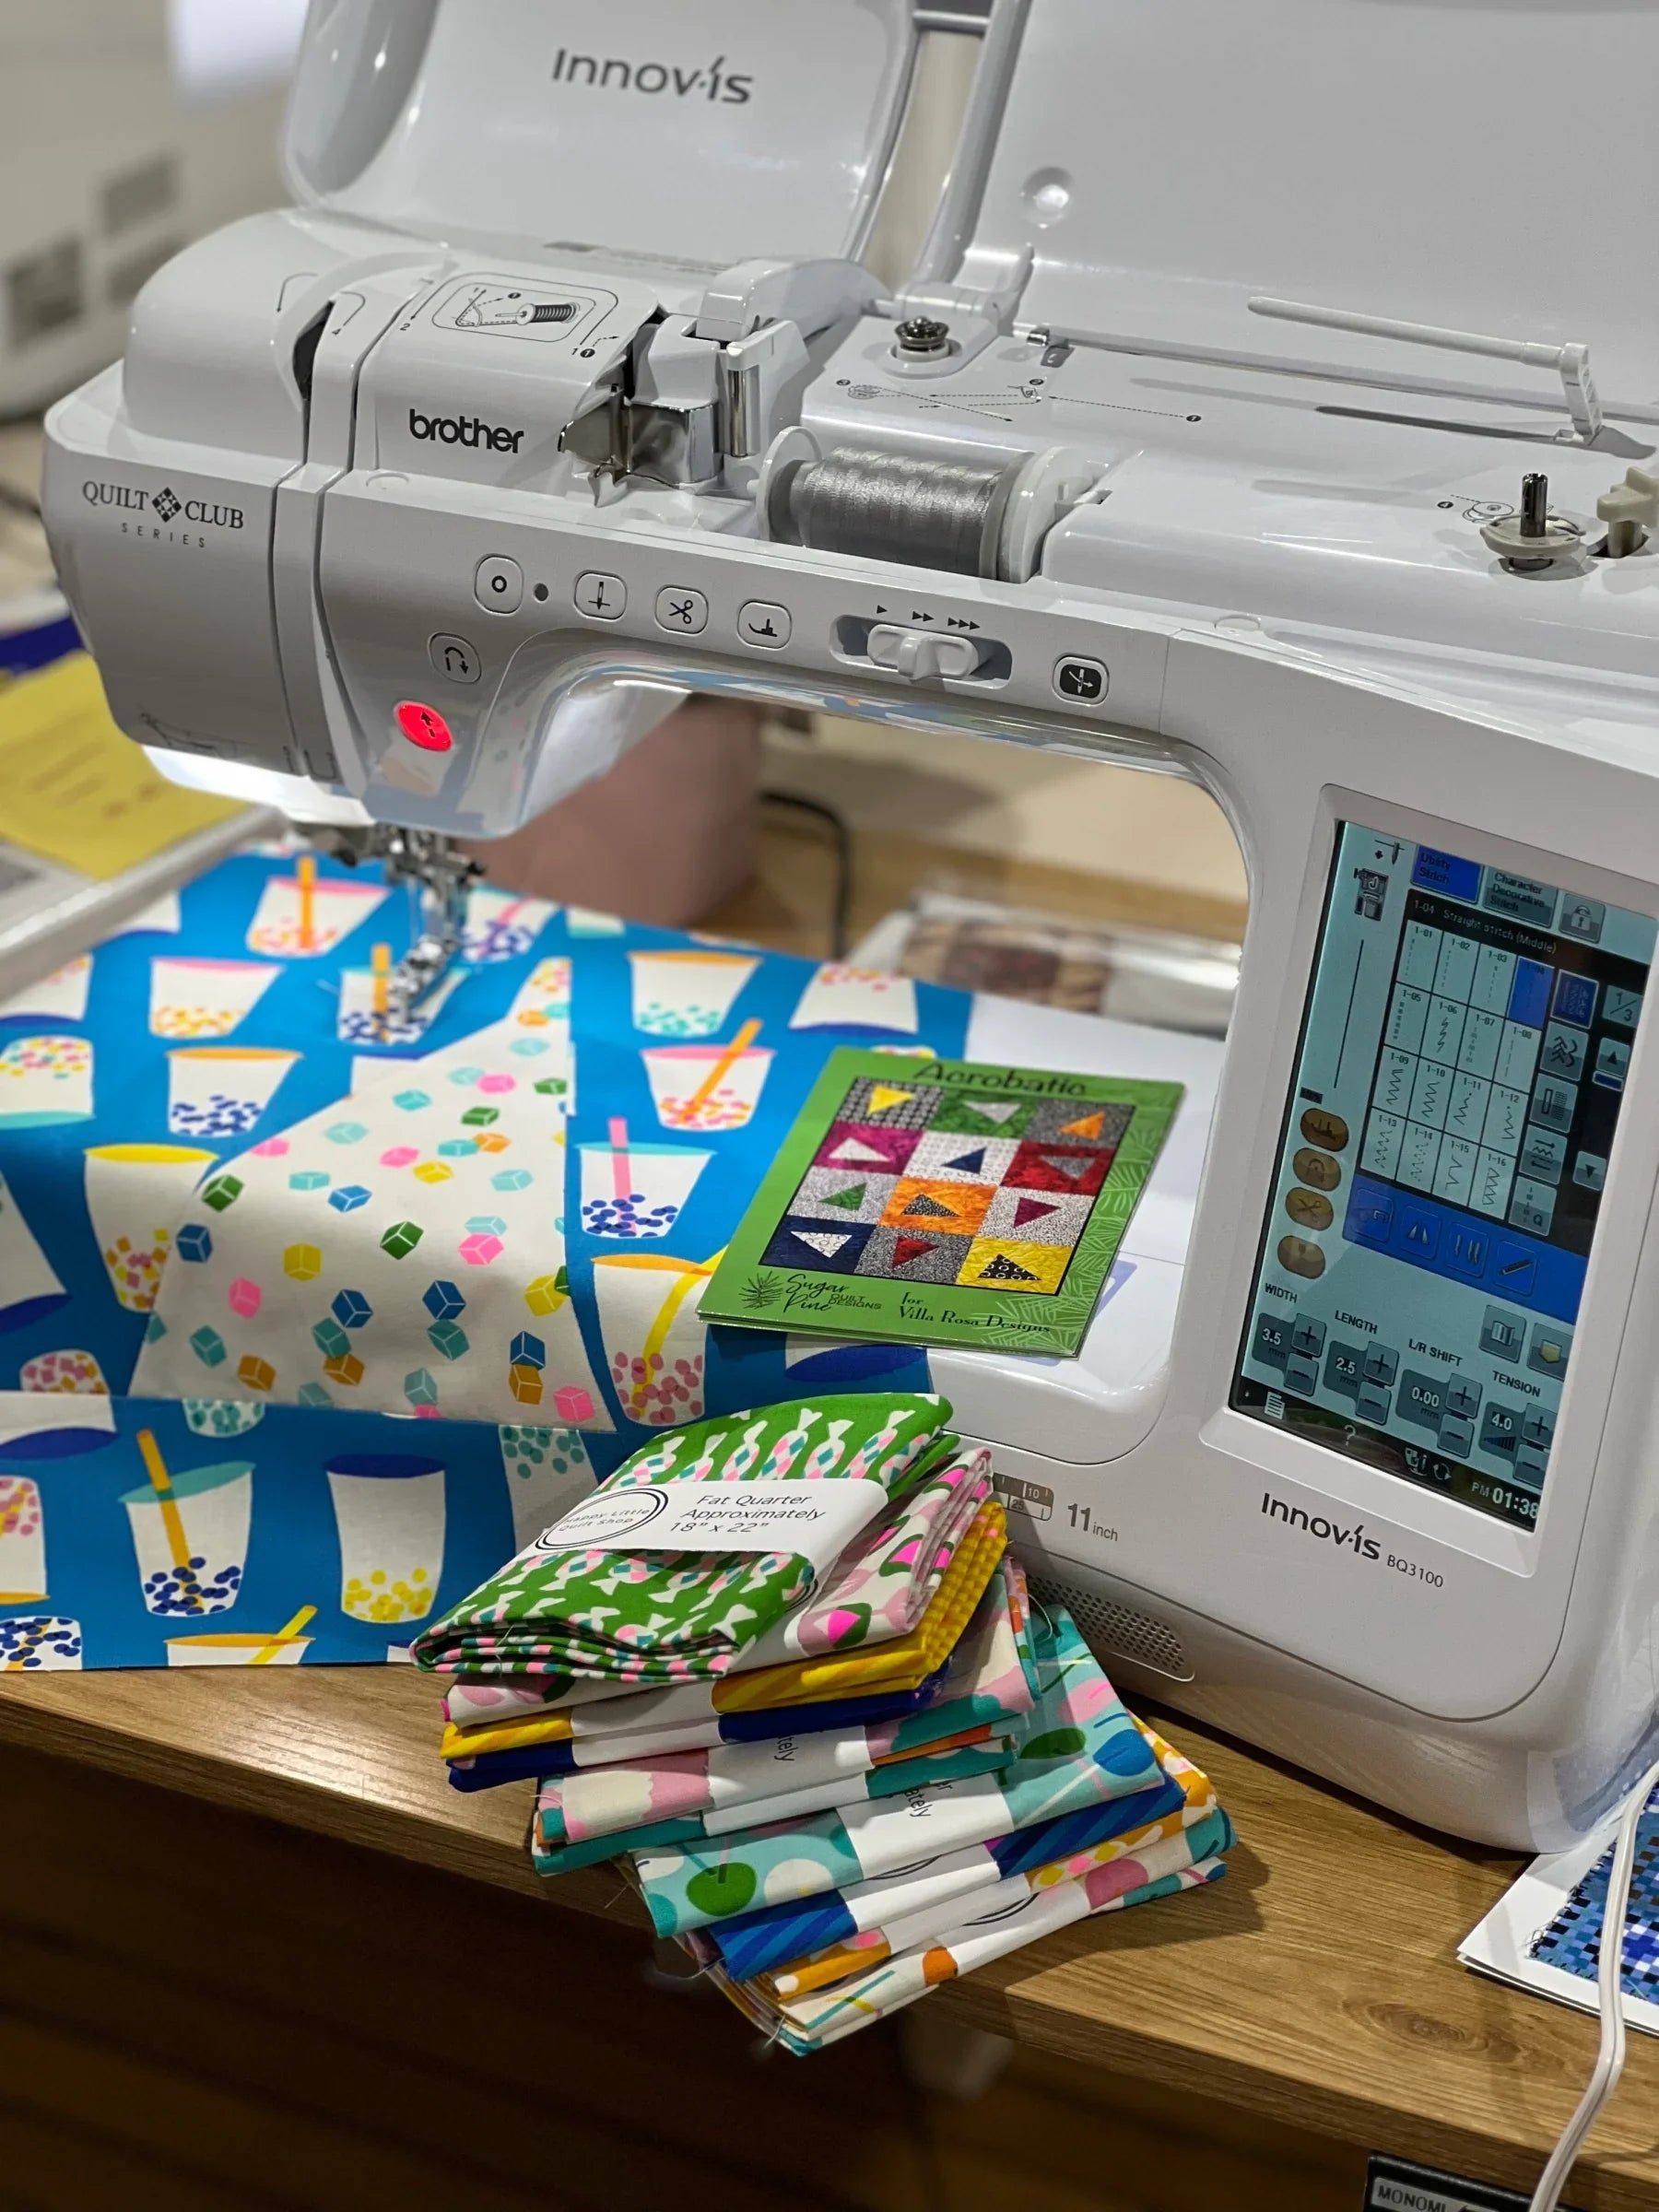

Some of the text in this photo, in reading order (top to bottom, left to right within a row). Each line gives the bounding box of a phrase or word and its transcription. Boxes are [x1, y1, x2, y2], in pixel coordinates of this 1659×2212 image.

[399, 323, 411, 332] 2
[571, 347, 579, 356] 1
[409, 408, 524, 454] brother
[82, 480, 244, 529] QUILT CLUB
[122, 523, 206, 548] SERIES
[1421, 853, 1451, 871] Utility
[1419, 866, 1449, 885] Stitch
[1494, 872, 1543, 895] Character
[1492, 884, 1546, 908] Decorative
[1490, 895, 1519, 912] Stitch
[1414, 900, 1557, 954] 1-04 Straight stitch (Middle)
[1415, 925, 1432, 938] 1-01
[1452, 937, 1470, 950] 1-02
[1488, 950, 1507, 963] 1-03
[1402, 989, 1421, 1002] 1-05
[1439, 1001, 1457, 1014] 1-06
[1476, 1014, 1495, 1026] 1-07
[1390, 1052, 1409, 1065] 1-09
[1427, 1065, 1445, 1077] 1-10
[914, 1061, 1086, 1096] Acrobatic
[1464, 1077, 1481, 1090] 1-11
[1500, 1090, 1520, 1103] 1-12
[1379, 1115, 1397, 1127] 1-13
[1415, 1127, 1432, 1140] 1-14
[1451, 1141, 1470, 1153] 1-15
[1488, 1153, 1507, 1166] 1-16
[786, 1273, 850, 1296] Sugar
[830, 1292, 865, 1303] QUILT
[901, 1290, 924, 1306] for
[1265, 1282, 1298, 1304] WIDTH
[783, 1292, 831, 1313] Pine
[829, 1298, 882, 1311] DESIGNS
[900, 1306, 1051, 1334] Villa Rosa Designs
[1335, 1310, 1378, 1335] LENGTH
[1262, 1327, 1282, 1346] 3.5
[1268, 1347, 1286, 1359] mm
[1408, 1338, 1463, 1367] L/R SHIFT
[1335, 1357, 1357, 1374] 2.5
[1340, 1376, 1358, 1388] mm
[1492, 1371, 1541, 1397] TENSION
[1411, 1386, 1440, 1407] 0.00
[1420, 1407, 1439, 1419] mm
[1491, 1413, 1512, 1431] 4.0
[697, 1494, 813, 1507] Fat Quarter
[1028, 1488, 1040, 1500] 10
[1471, 1481, 1539, 1519] PM 01:38
[1010, 1499, 1025, 1511] 25
[611, 1508, 651, 1517] Little
[679, 1508, 828, 1522] Approximately
[559, 1517, 634, 1532] Quilt Shop
[1067, 1502, 1118, 1542] 11 inch
[1387, 1554, 1444, 1588] BQ3100
